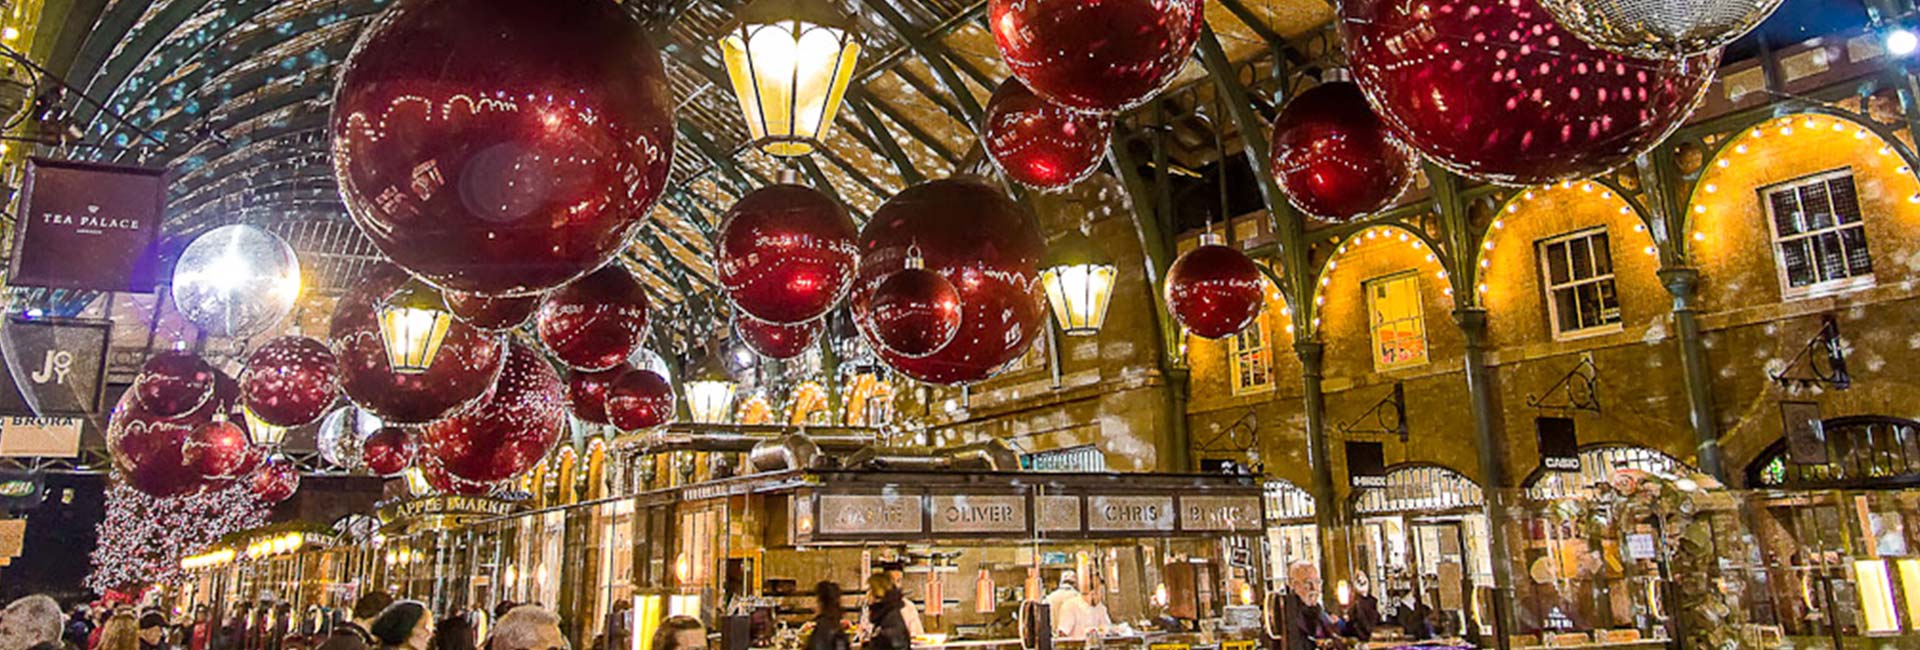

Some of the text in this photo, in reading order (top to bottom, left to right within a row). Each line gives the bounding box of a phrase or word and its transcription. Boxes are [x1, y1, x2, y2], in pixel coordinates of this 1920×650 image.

[43, 213, 139, 230] TEA PALACE
[1545, 457, 1579, 469] CASIO
[396, 497, 442, 517] APPLE
[945, 505, 1013, 523] OLIVER
[1105, 505, 1158, 522] CHRIS
